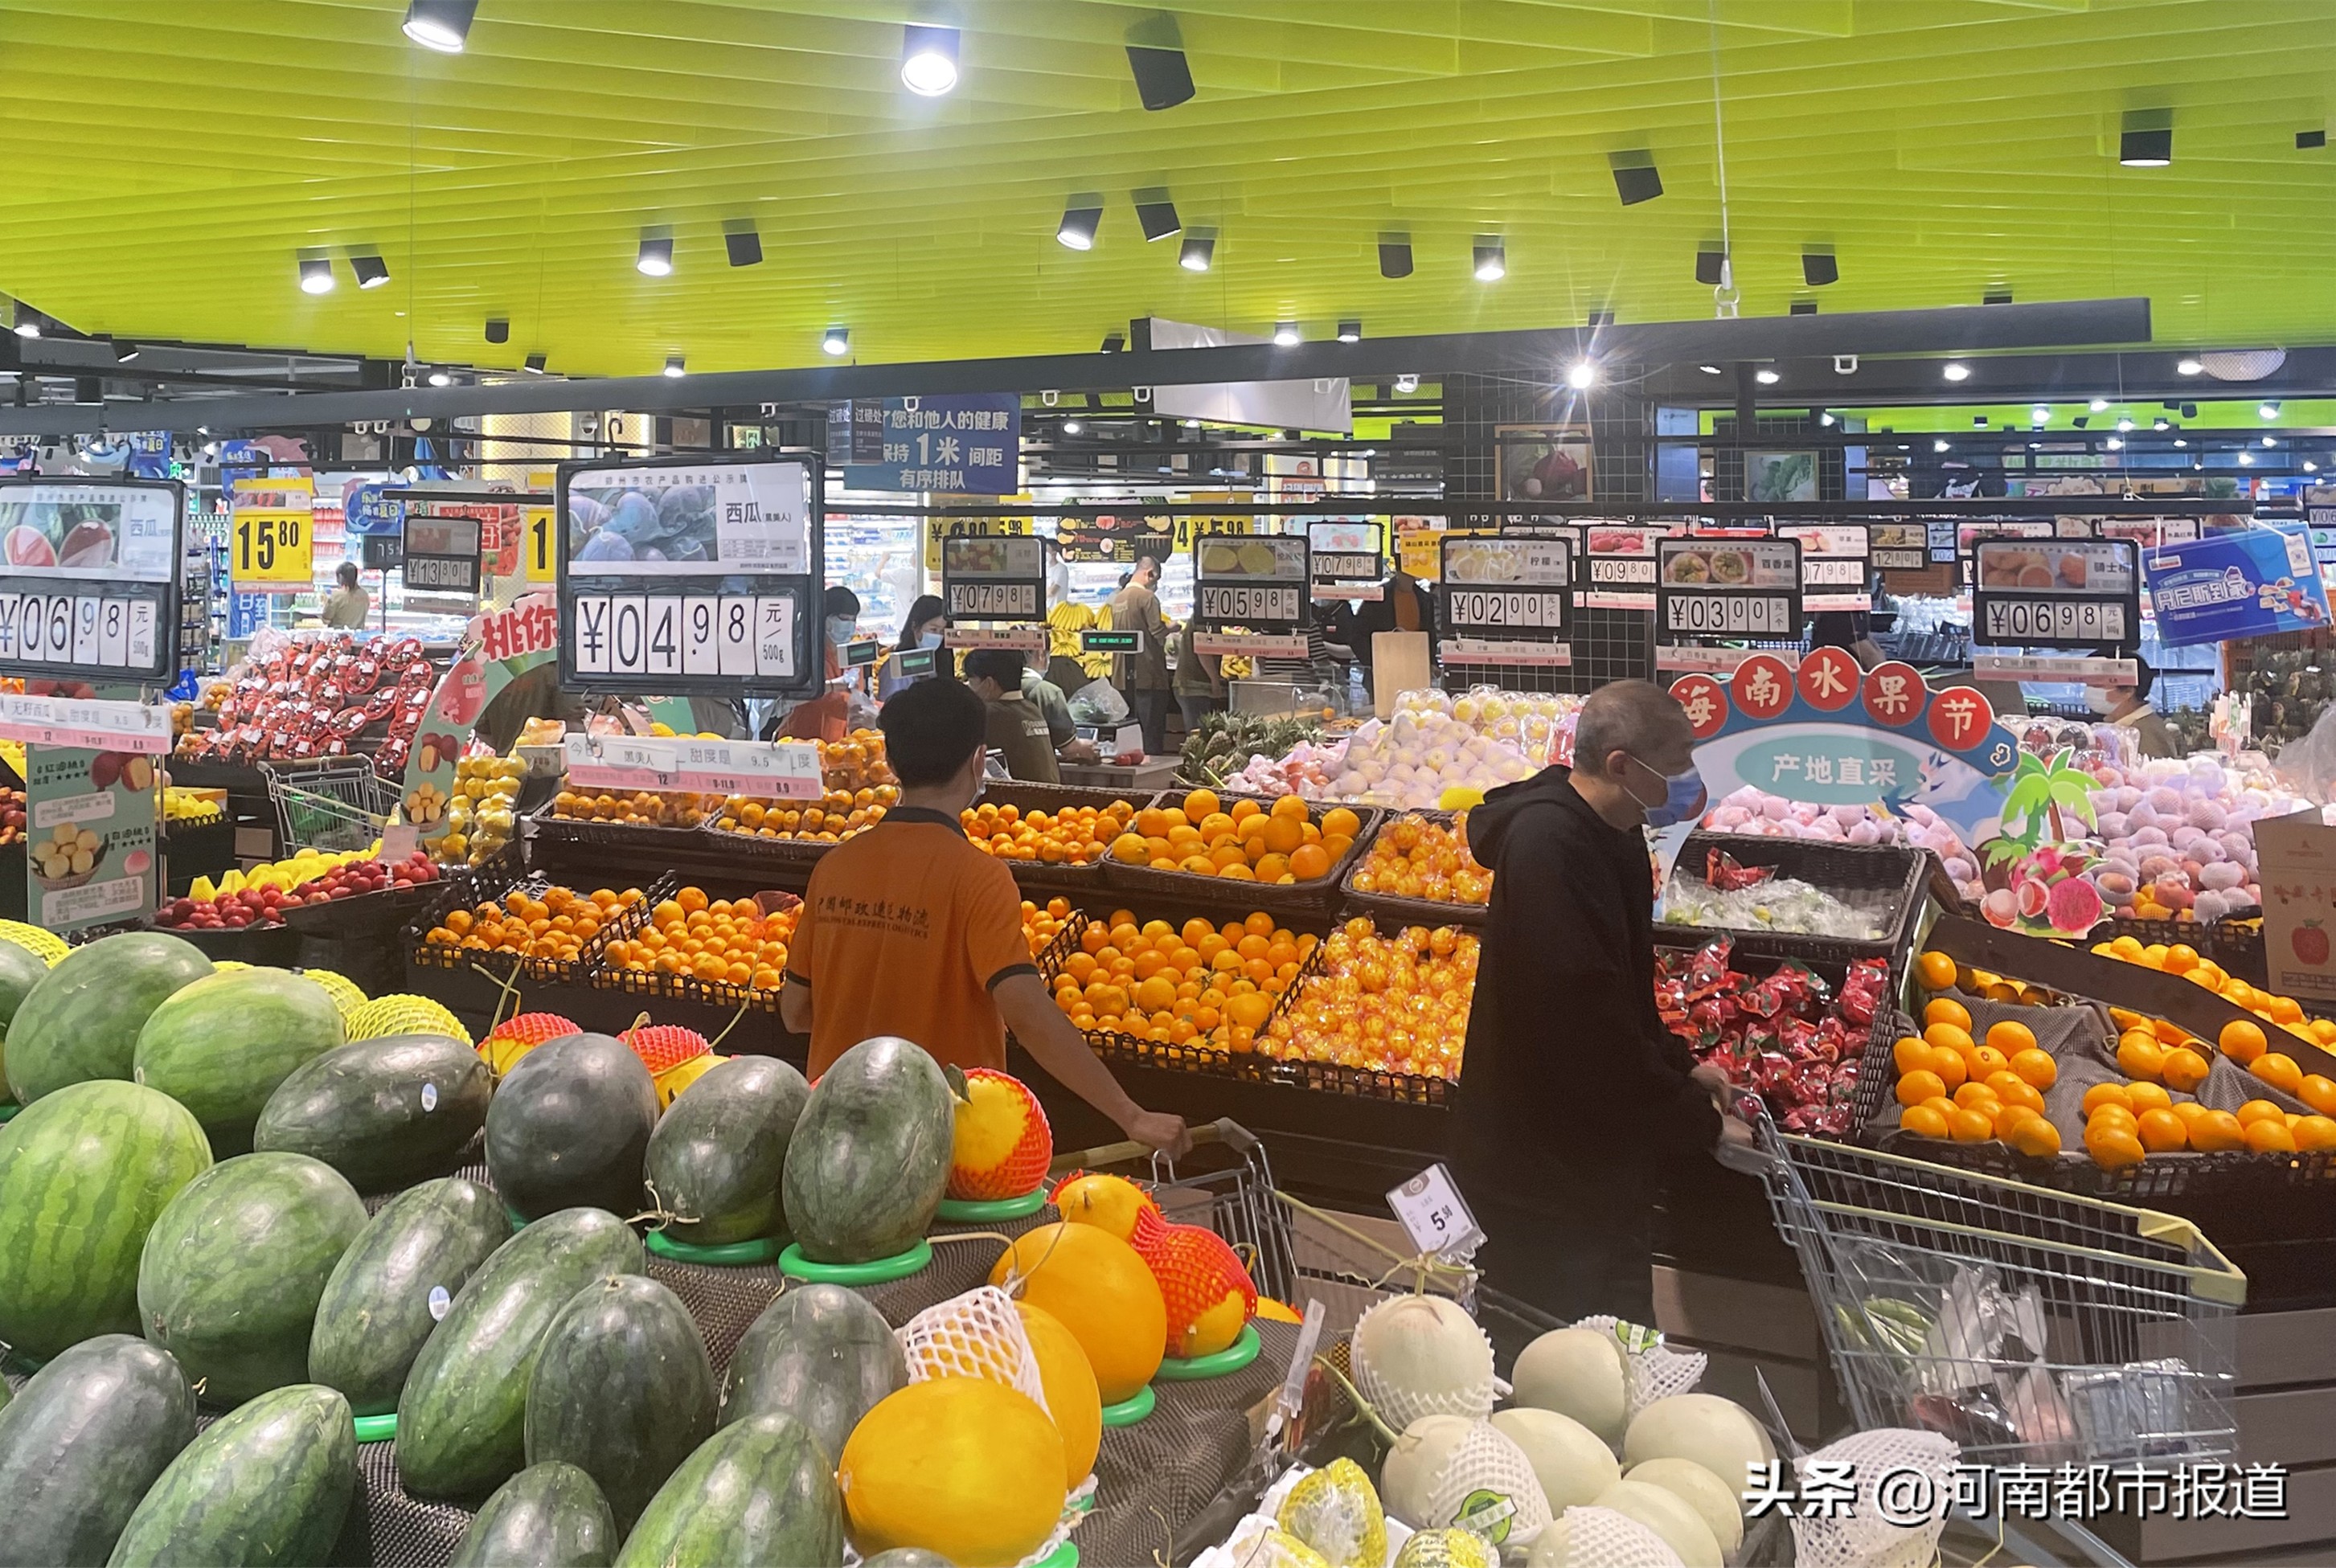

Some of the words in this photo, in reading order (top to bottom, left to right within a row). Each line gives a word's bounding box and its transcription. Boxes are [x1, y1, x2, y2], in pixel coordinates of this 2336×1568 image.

[855, 407, 883, 424] 过磅处
[969, 448, 1003, 467] 间距
[900, 469, 966, 489] 有序排队
[726, 502, 761, 524] 西瓜
[130, 518, 158, 538] 西瓜
[2155, 579, 2248, 610] 丹尼斯到家
[1681, 657, 1977, 741] 海南水果节
[690, 747, 732, 764] 甜度是
[797, 753, 813, 770] 度
[658, 773, 669, 786] 12
[1772, 753, 1898, 787] 产地直采
